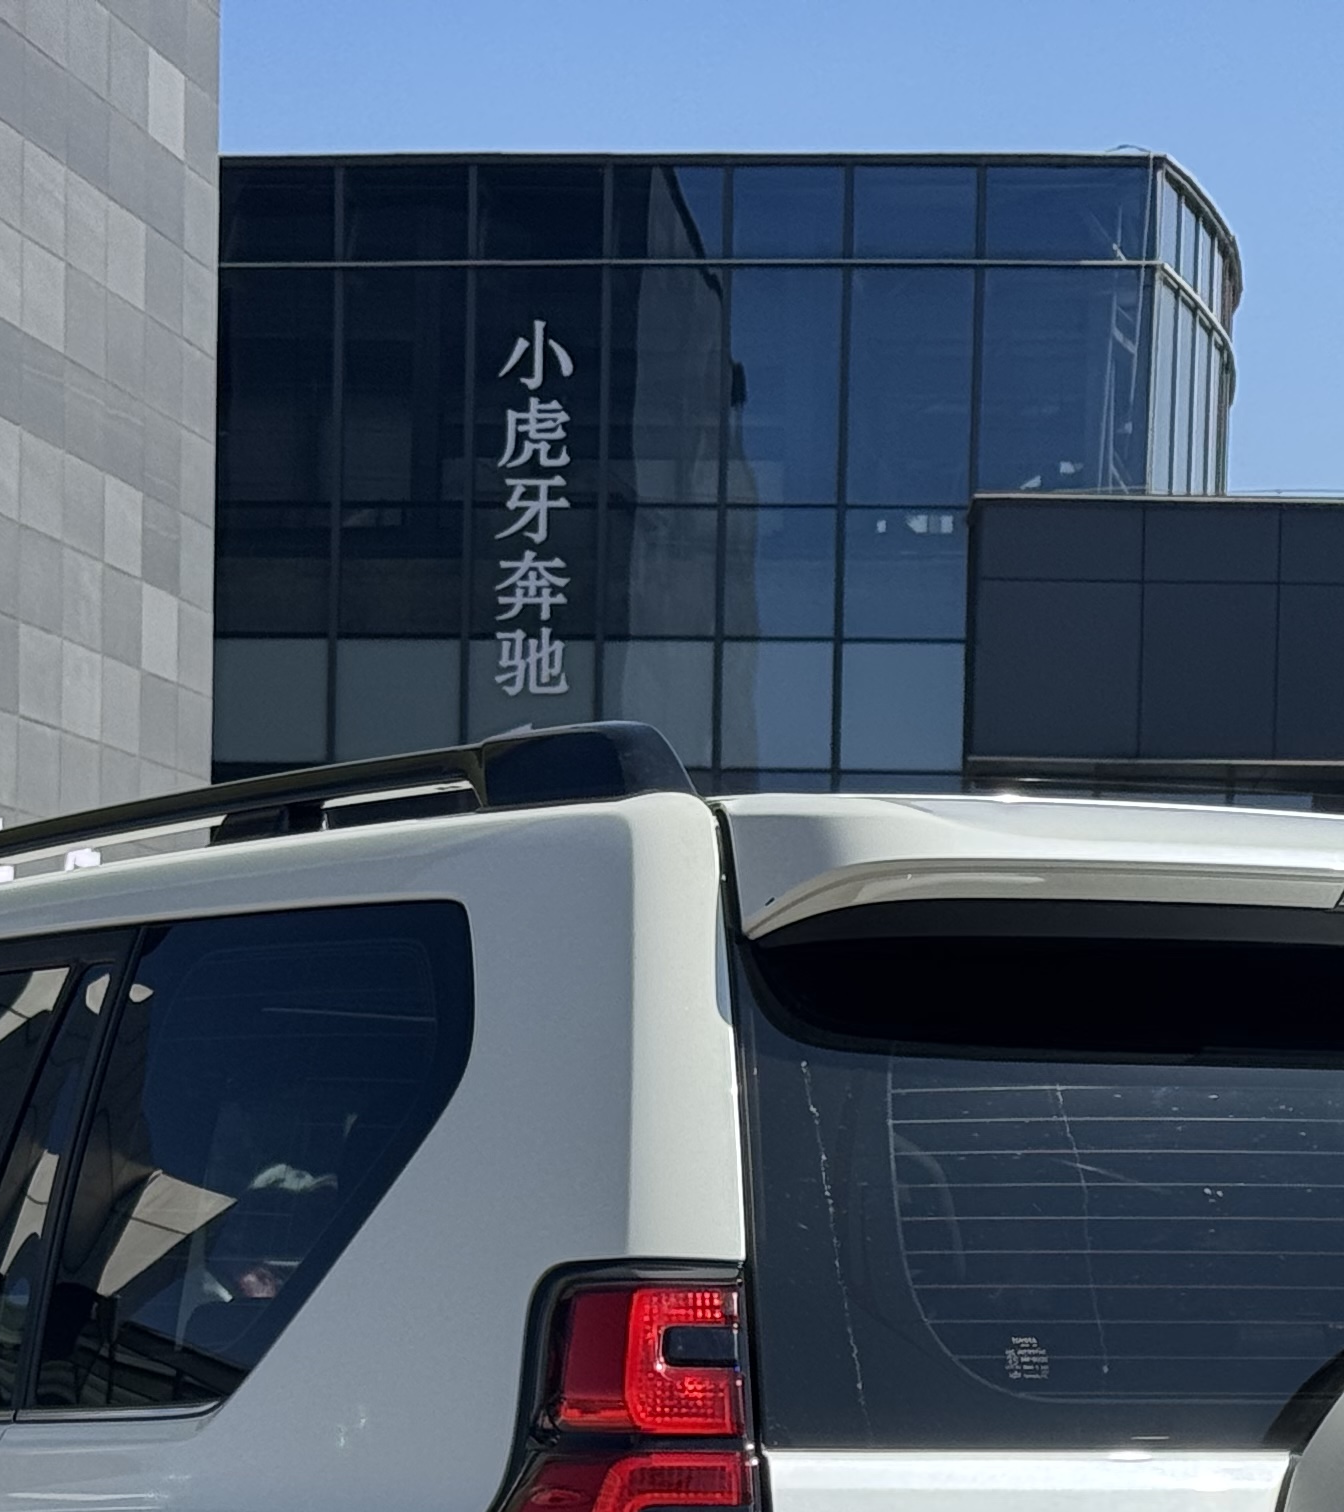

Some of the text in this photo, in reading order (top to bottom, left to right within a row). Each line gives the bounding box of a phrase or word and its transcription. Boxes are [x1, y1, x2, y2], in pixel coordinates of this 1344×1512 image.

[494, 320, 574, 735] 小虎牙奔驰
